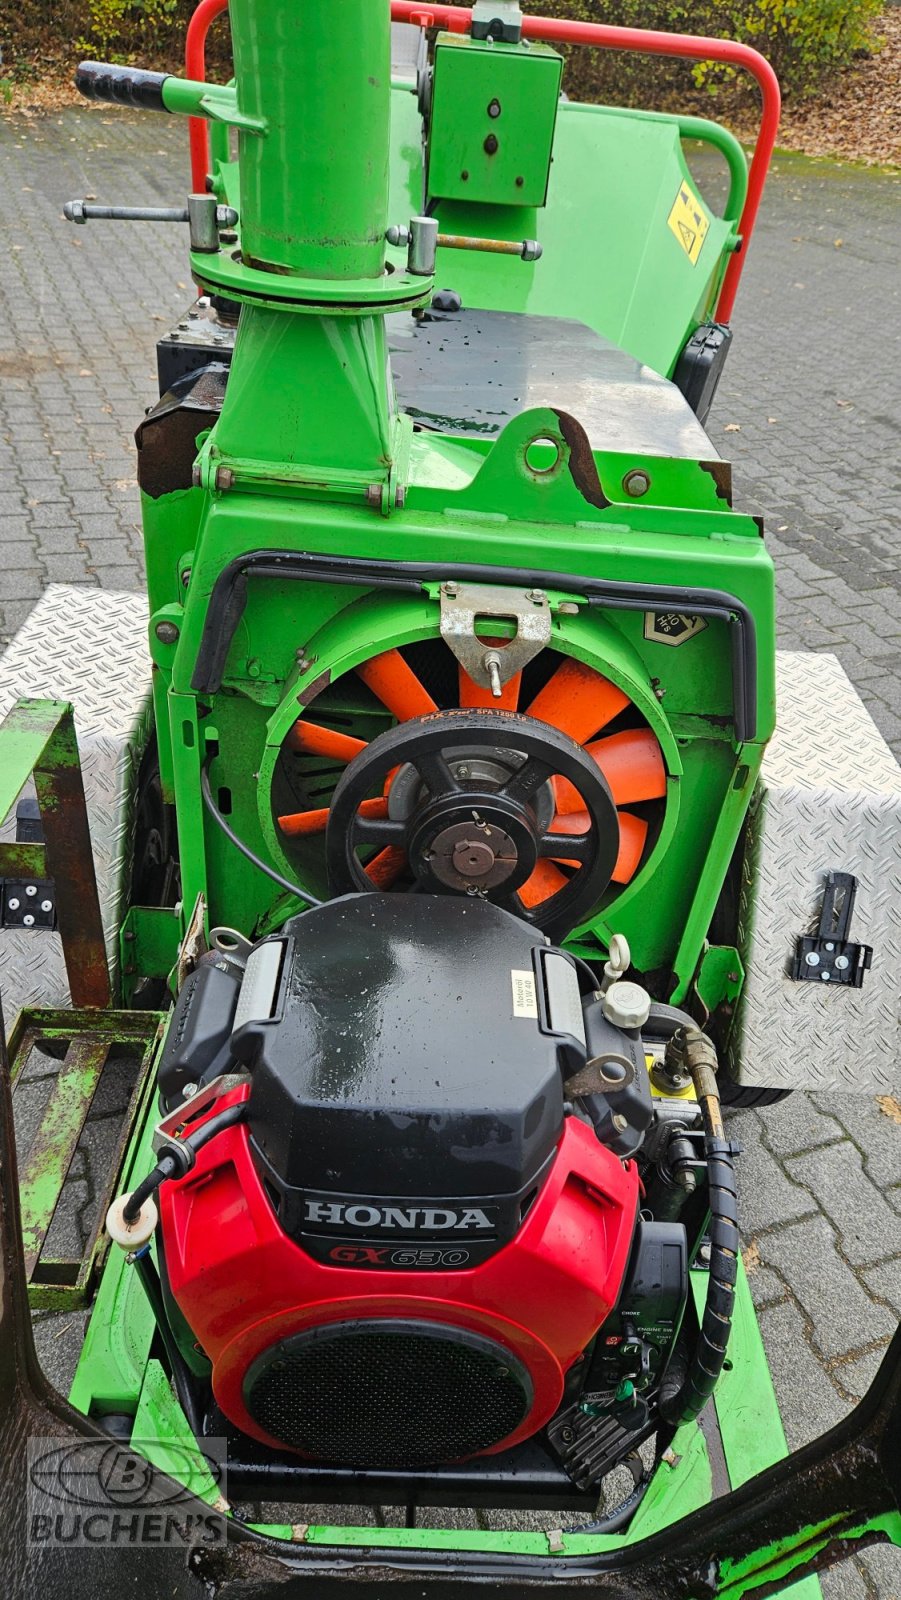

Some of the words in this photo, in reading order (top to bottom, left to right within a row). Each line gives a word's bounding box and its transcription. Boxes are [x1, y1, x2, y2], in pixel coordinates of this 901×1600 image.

[657, 615, 671, 632] Hrs
[667, 613, 679, 625] 40
[304, 1201, 495, 1229] HONDA
